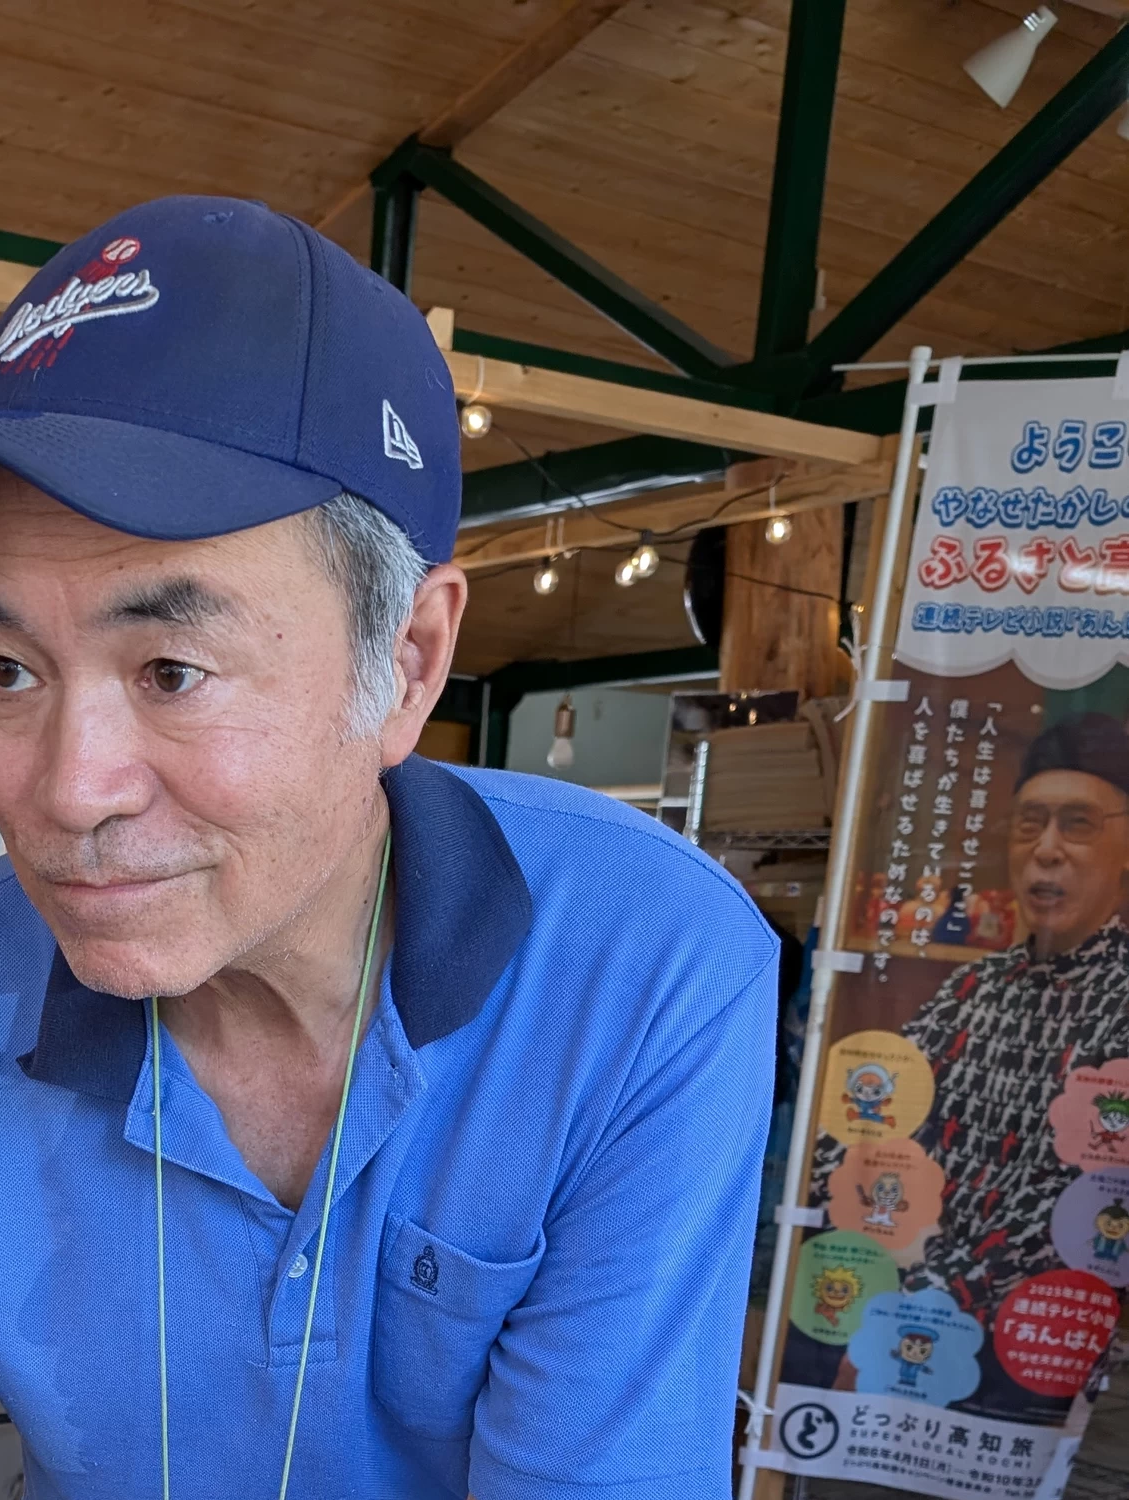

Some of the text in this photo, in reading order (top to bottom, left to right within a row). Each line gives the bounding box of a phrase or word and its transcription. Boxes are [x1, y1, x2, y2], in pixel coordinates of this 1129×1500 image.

[1011, 420, 1129, 473] ようこ
[851, 1404, 1036, 1458] どっぷり高知旅
